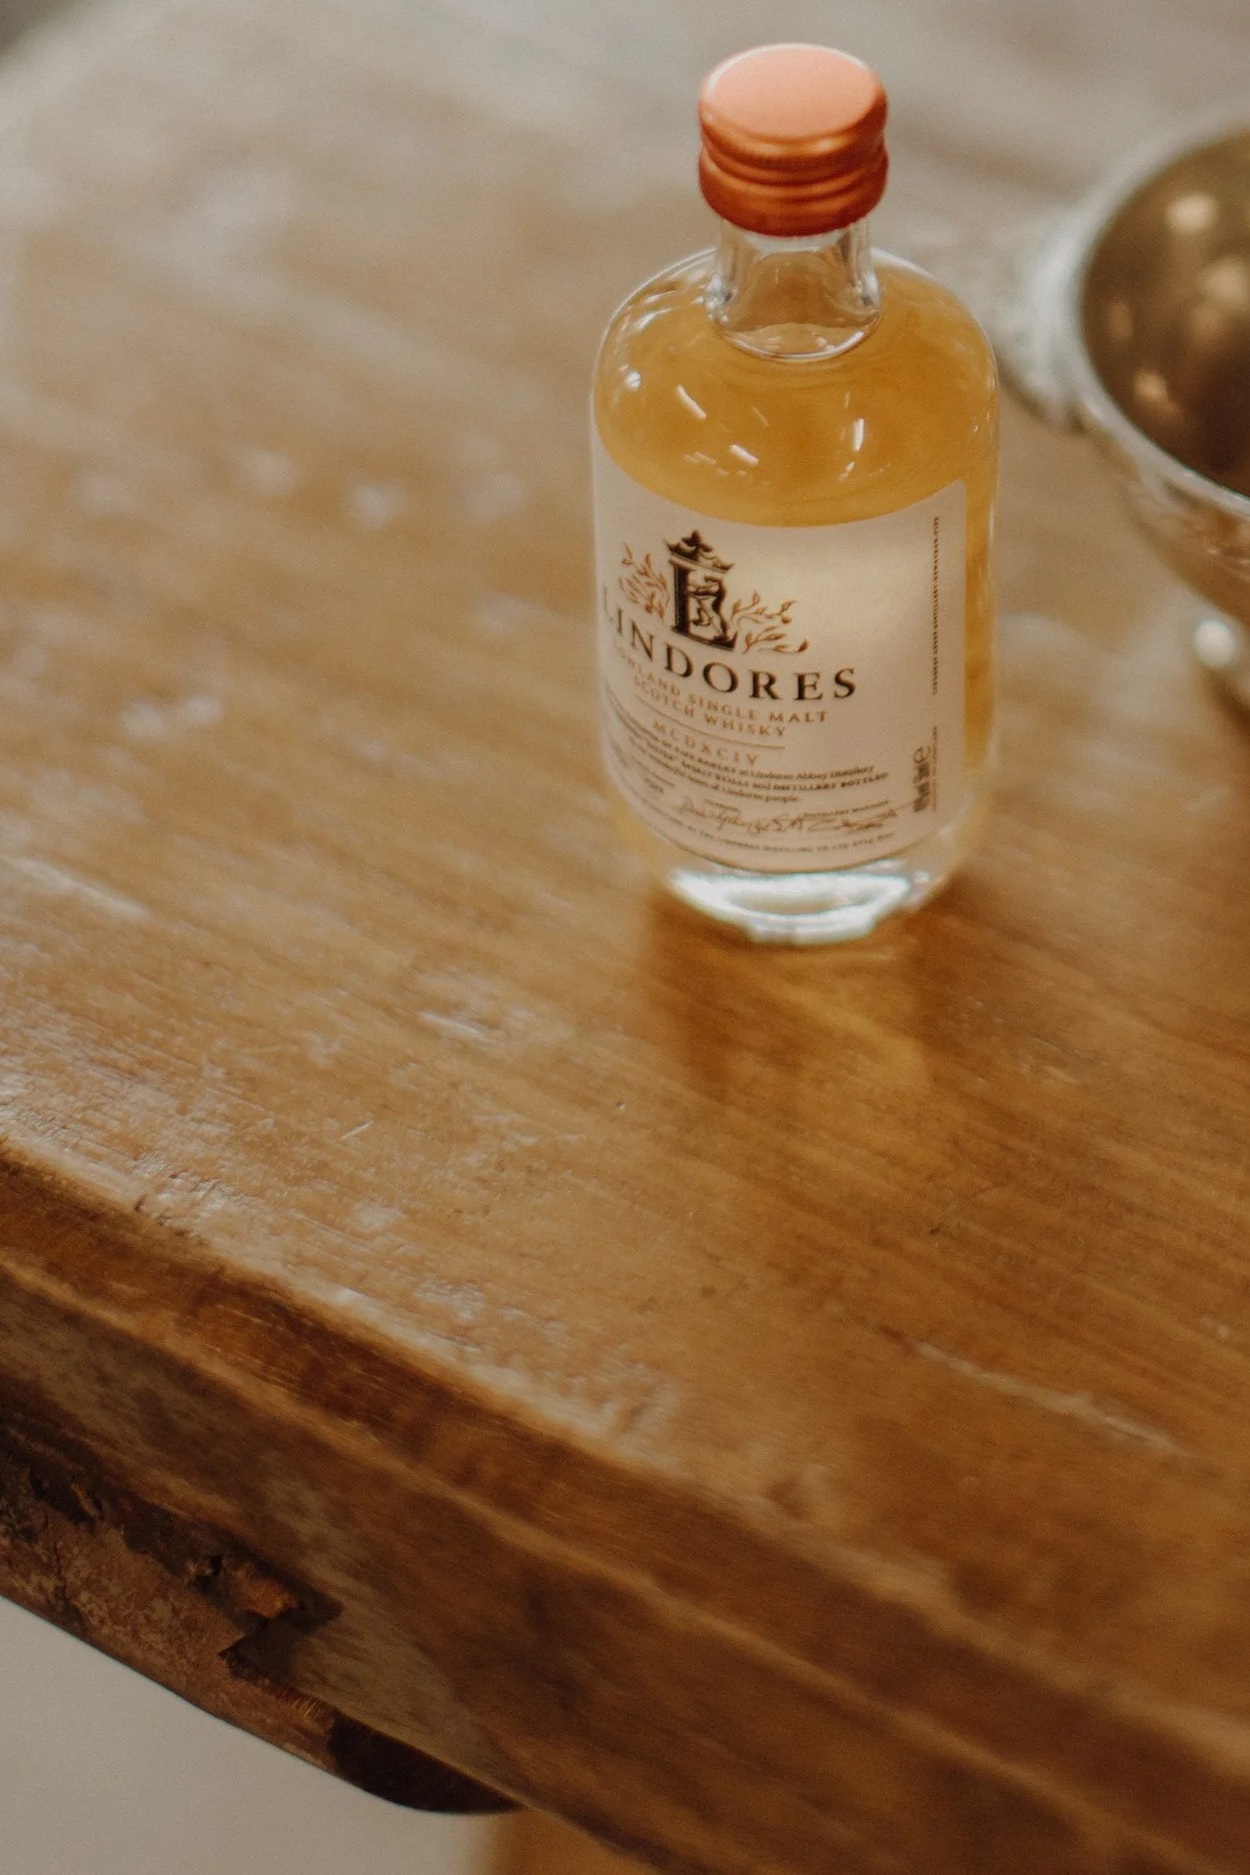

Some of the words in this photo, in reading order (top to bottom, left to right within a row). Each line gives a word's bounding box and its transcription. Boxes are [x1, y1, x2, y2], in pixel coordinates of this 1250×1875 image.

[603, 581, 856, 701] LINDORES
[633, 676, 694, 718] SCOTCH
[704, 713, 785, 737] WHISKY
[688, 692, 757, 720] SINGLE
[769, 709, 828, 723] MALT
